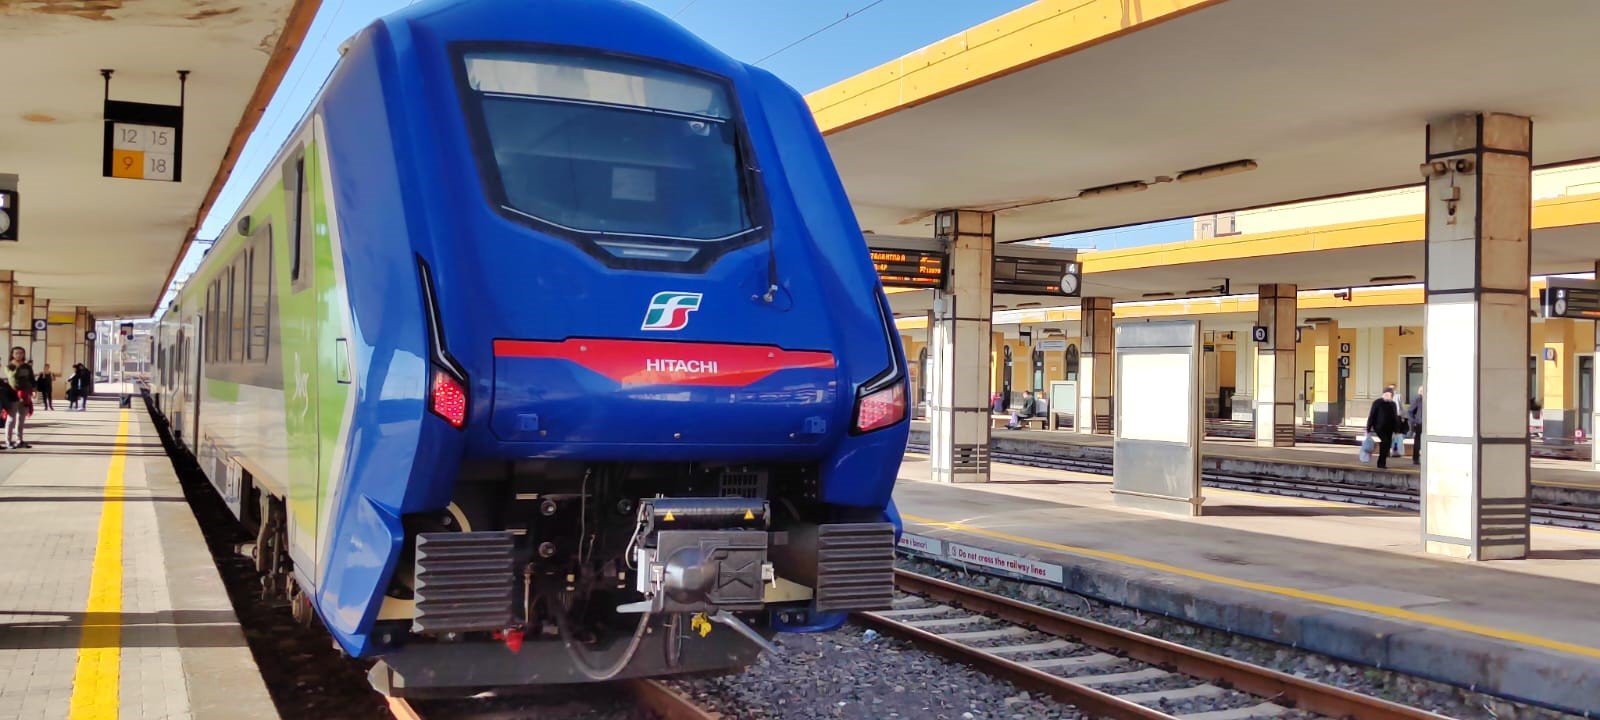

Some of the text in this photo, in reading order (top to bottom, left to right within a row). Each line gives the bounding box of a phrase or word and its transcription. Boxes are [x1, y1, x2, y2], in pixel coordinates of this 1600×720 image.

[121, 128, 137, 144] 12
[152, 131, 168, 146] 15
[123, 156, 134, 171] 9
[151, 158, 167, 173] 18
[1068, 263, 1075, 273] 4
[1558, 289, 1564, 298] 3
[646, 358, 718, 374] HITACHI
[958, 548, 1046, 576] Do not cross the railway lines
